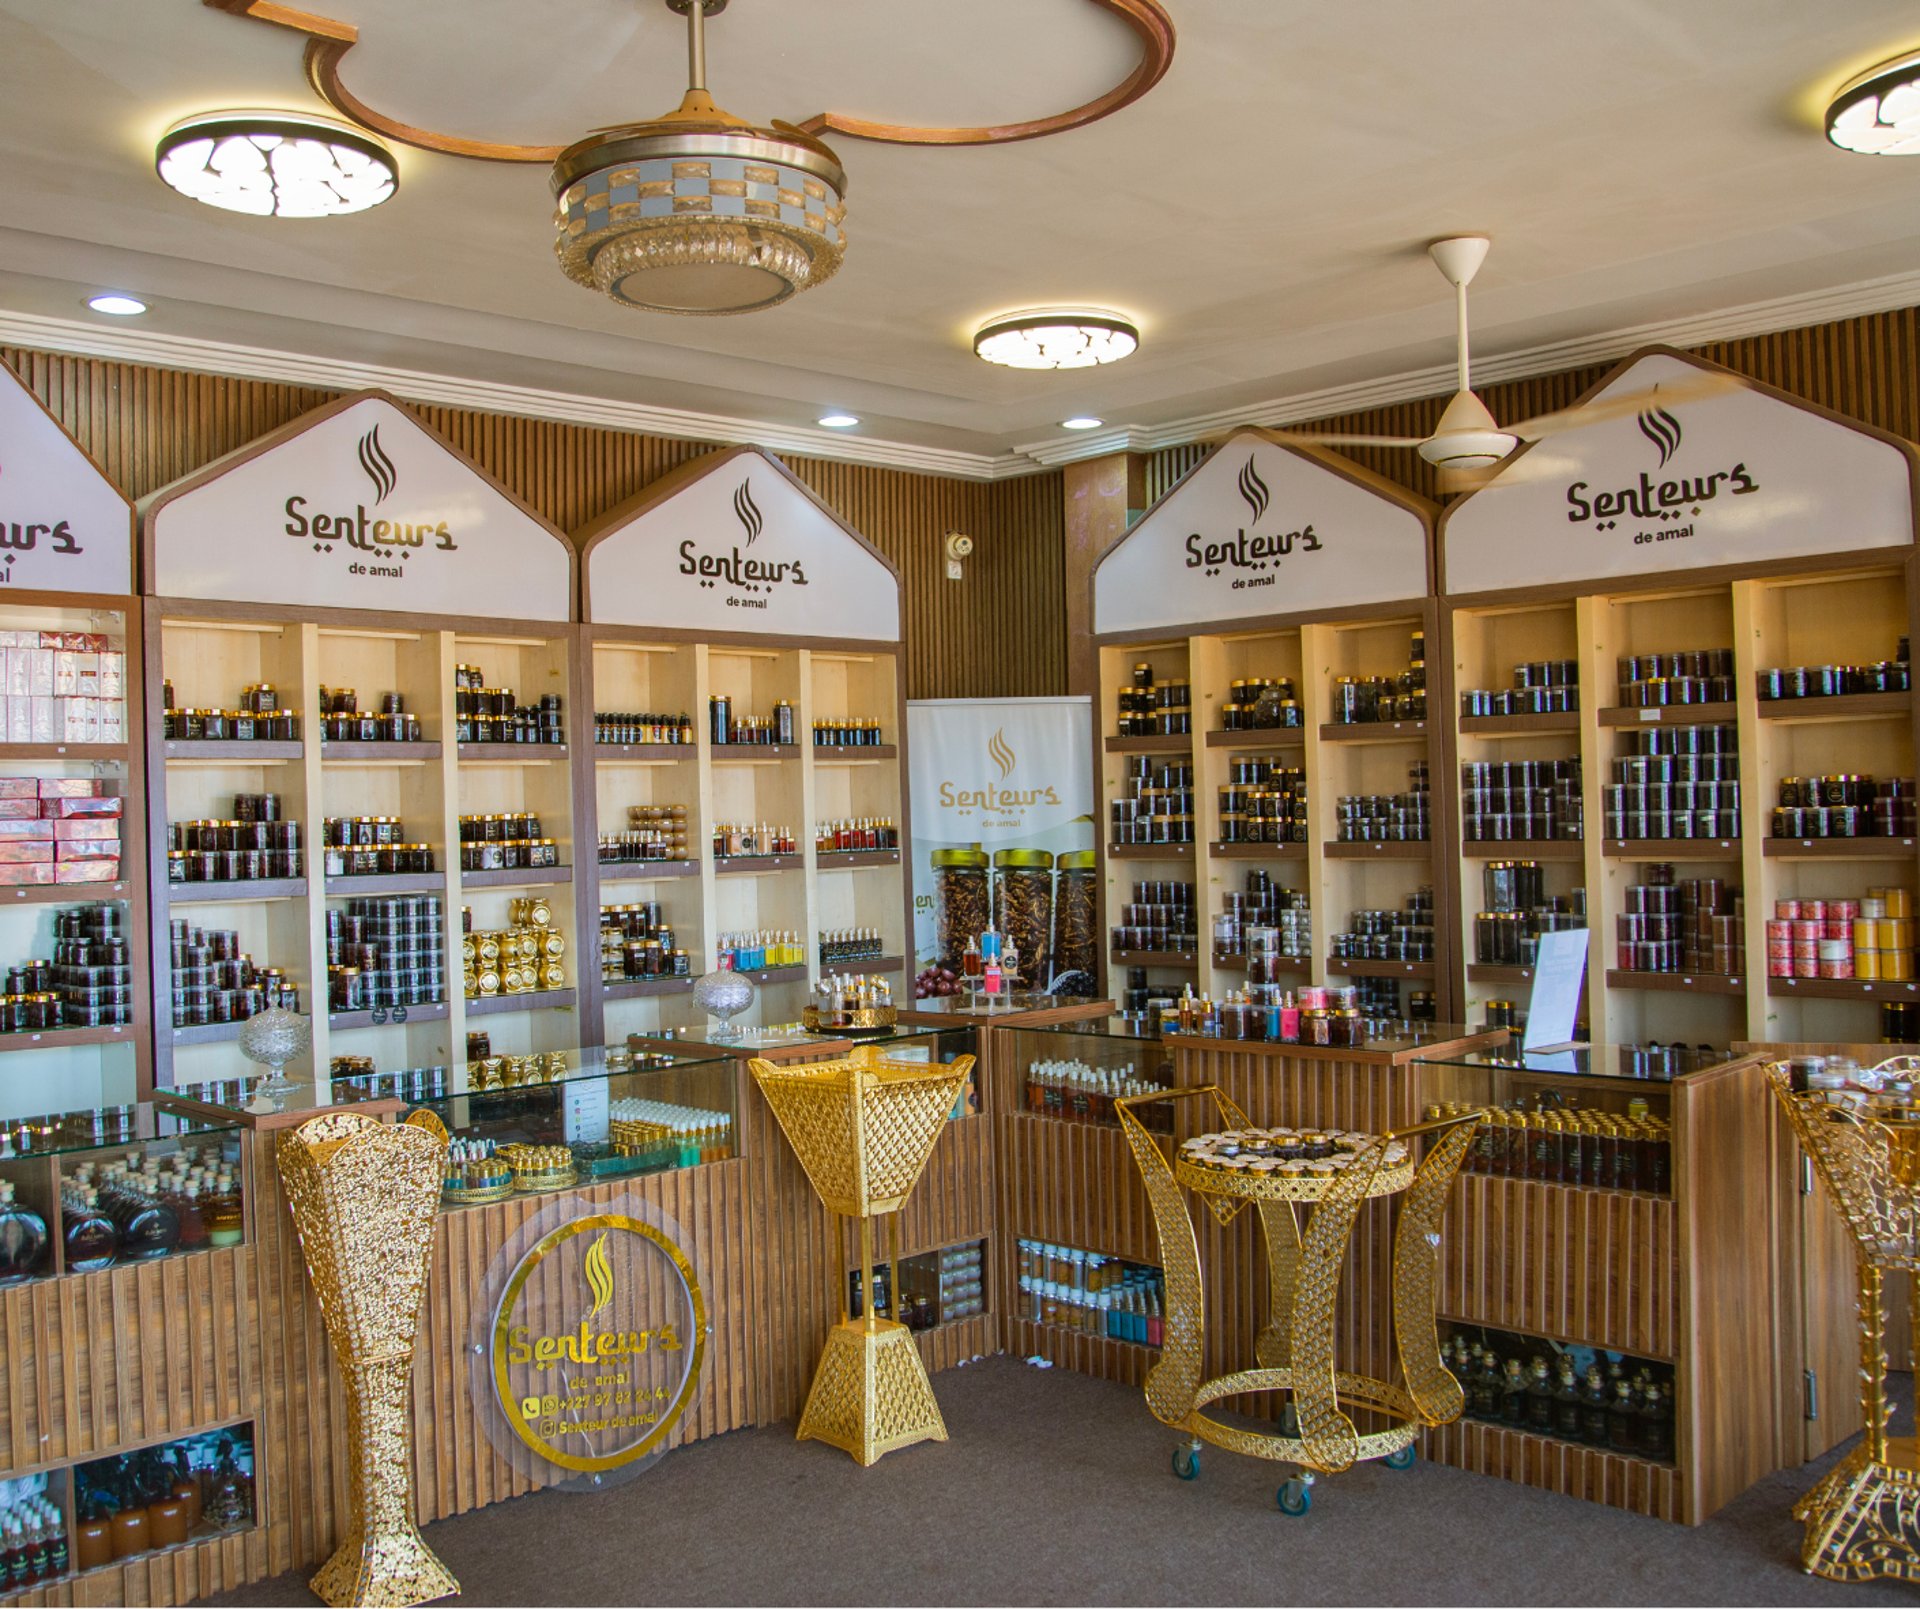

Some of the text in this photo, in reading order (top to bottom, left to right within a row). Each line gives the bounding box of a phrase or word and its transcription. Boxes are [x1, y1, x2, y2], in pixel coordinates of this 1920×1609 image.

[1567, 463, 1760, 532] Senteurs
[285, 496, 458, 560] Senteurs
[1634, 524, 1694, 545] de amal
[1186, 524, 1323, 577] Senteurs
[349, 562, 403, 578] de amal
[679, 540, 808, 593] Senteurs
[1231, 574, 1275, 589] de amal
[726, 596, 767, 609] de amal
[939, 781, 1062, 815] Senteurs
[982, 819, 1021, 828] de amal
[508, 1322, 683, 1370] Senteurs
[569, 1370, 630, 1390] de amal
